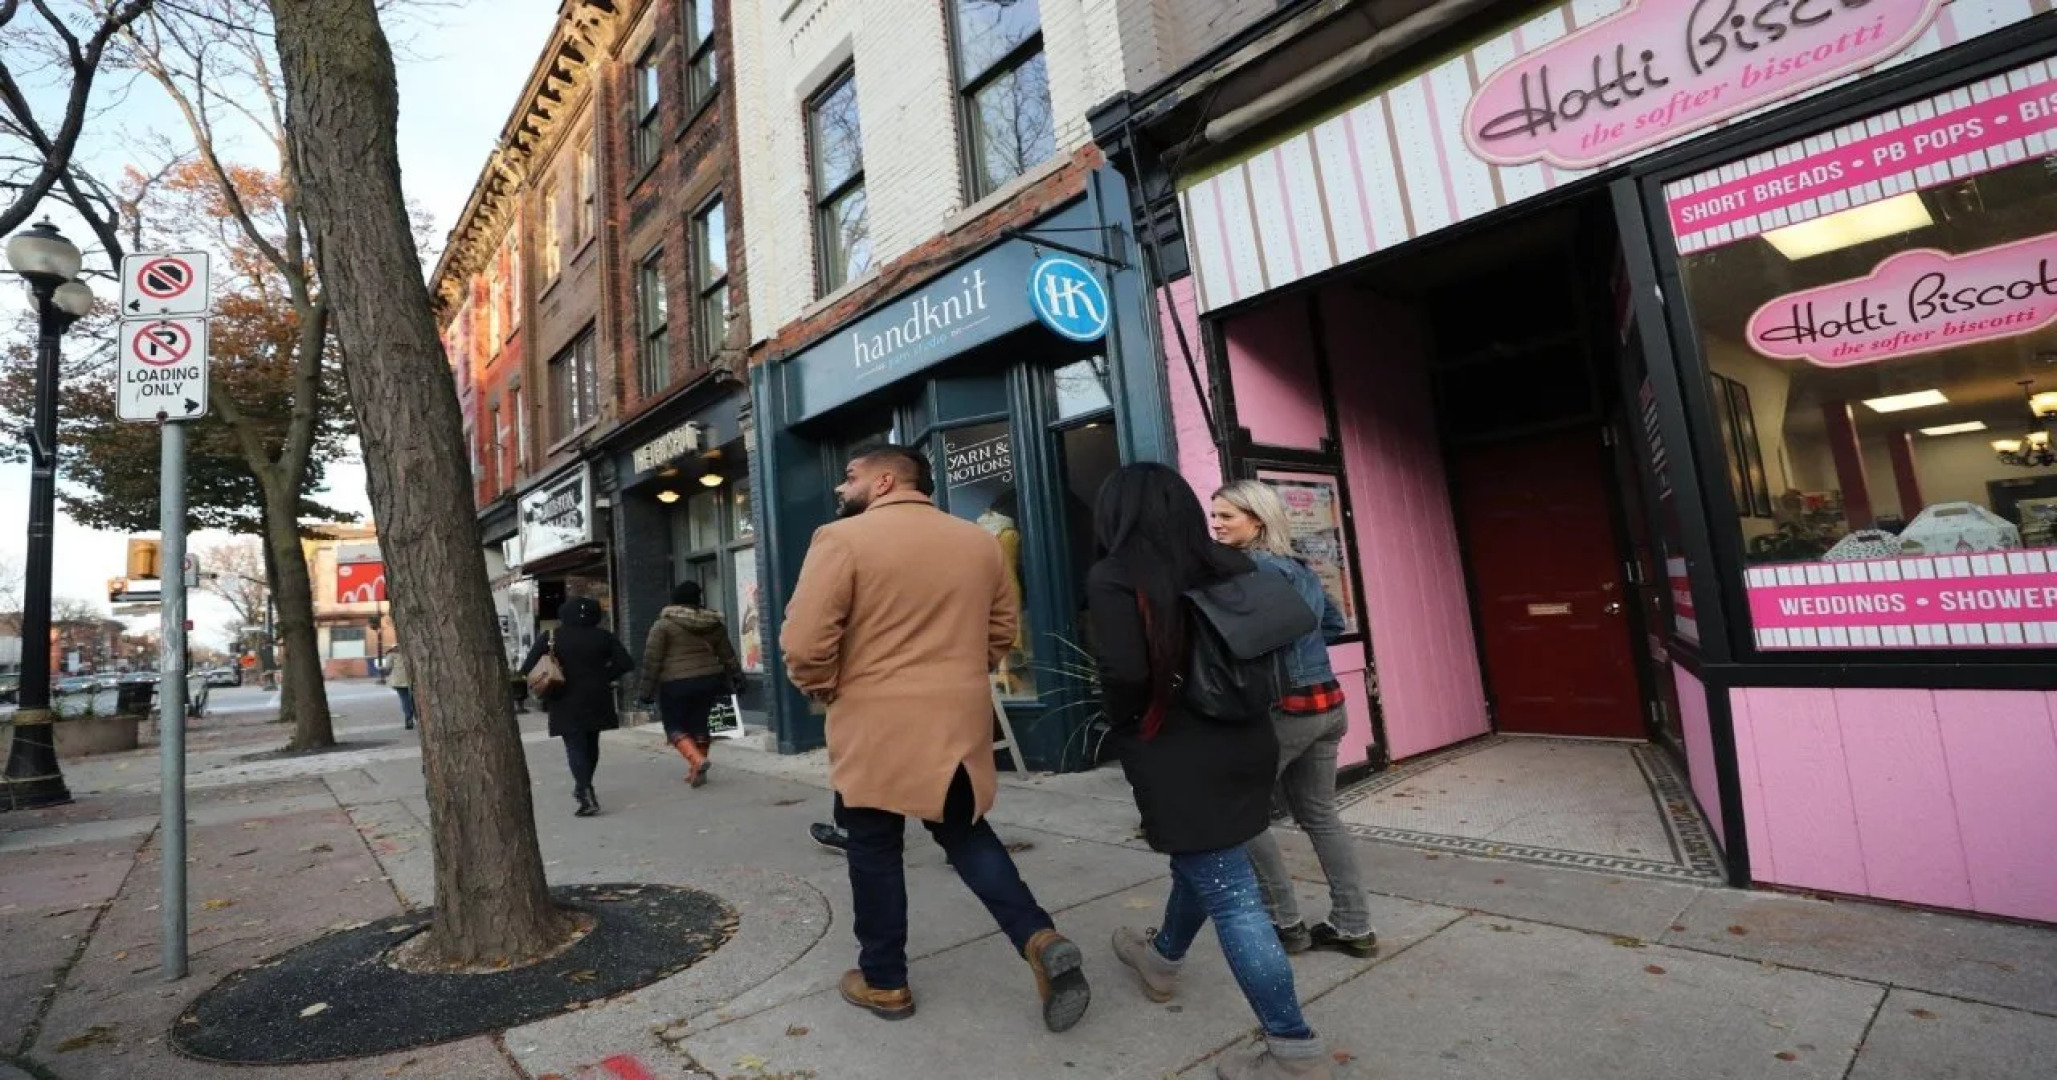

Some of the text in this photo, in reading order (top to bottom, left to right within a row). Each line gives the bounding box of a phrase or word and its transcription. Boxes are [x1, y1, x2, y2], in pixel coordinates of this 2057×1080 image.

[1479, 43, 1669, 141] Hotti
[1580, 15, 1886, 150] the softer biscotti
[1681, 190, 1747, 224] SHORT
[1754, 160, 1845, 204] BREADS
[1872, 142, 1908, 167] PB
[1914, 117, 1985, 154] POPS
[853, 268, 987, 369] handknit
[1759, 297, 1897, 345] Hotti
[1832, 306, 2038, 359] the softer biscotti
[127, 366, 200, 384] LOADING
[141, 382, 184, 397] ONLY
[947, 441, 1010, 471] YARN &
[948, 454, 1012, 483] NOTIONS
[1779, 592, 1906, 616] WEDDINGS
